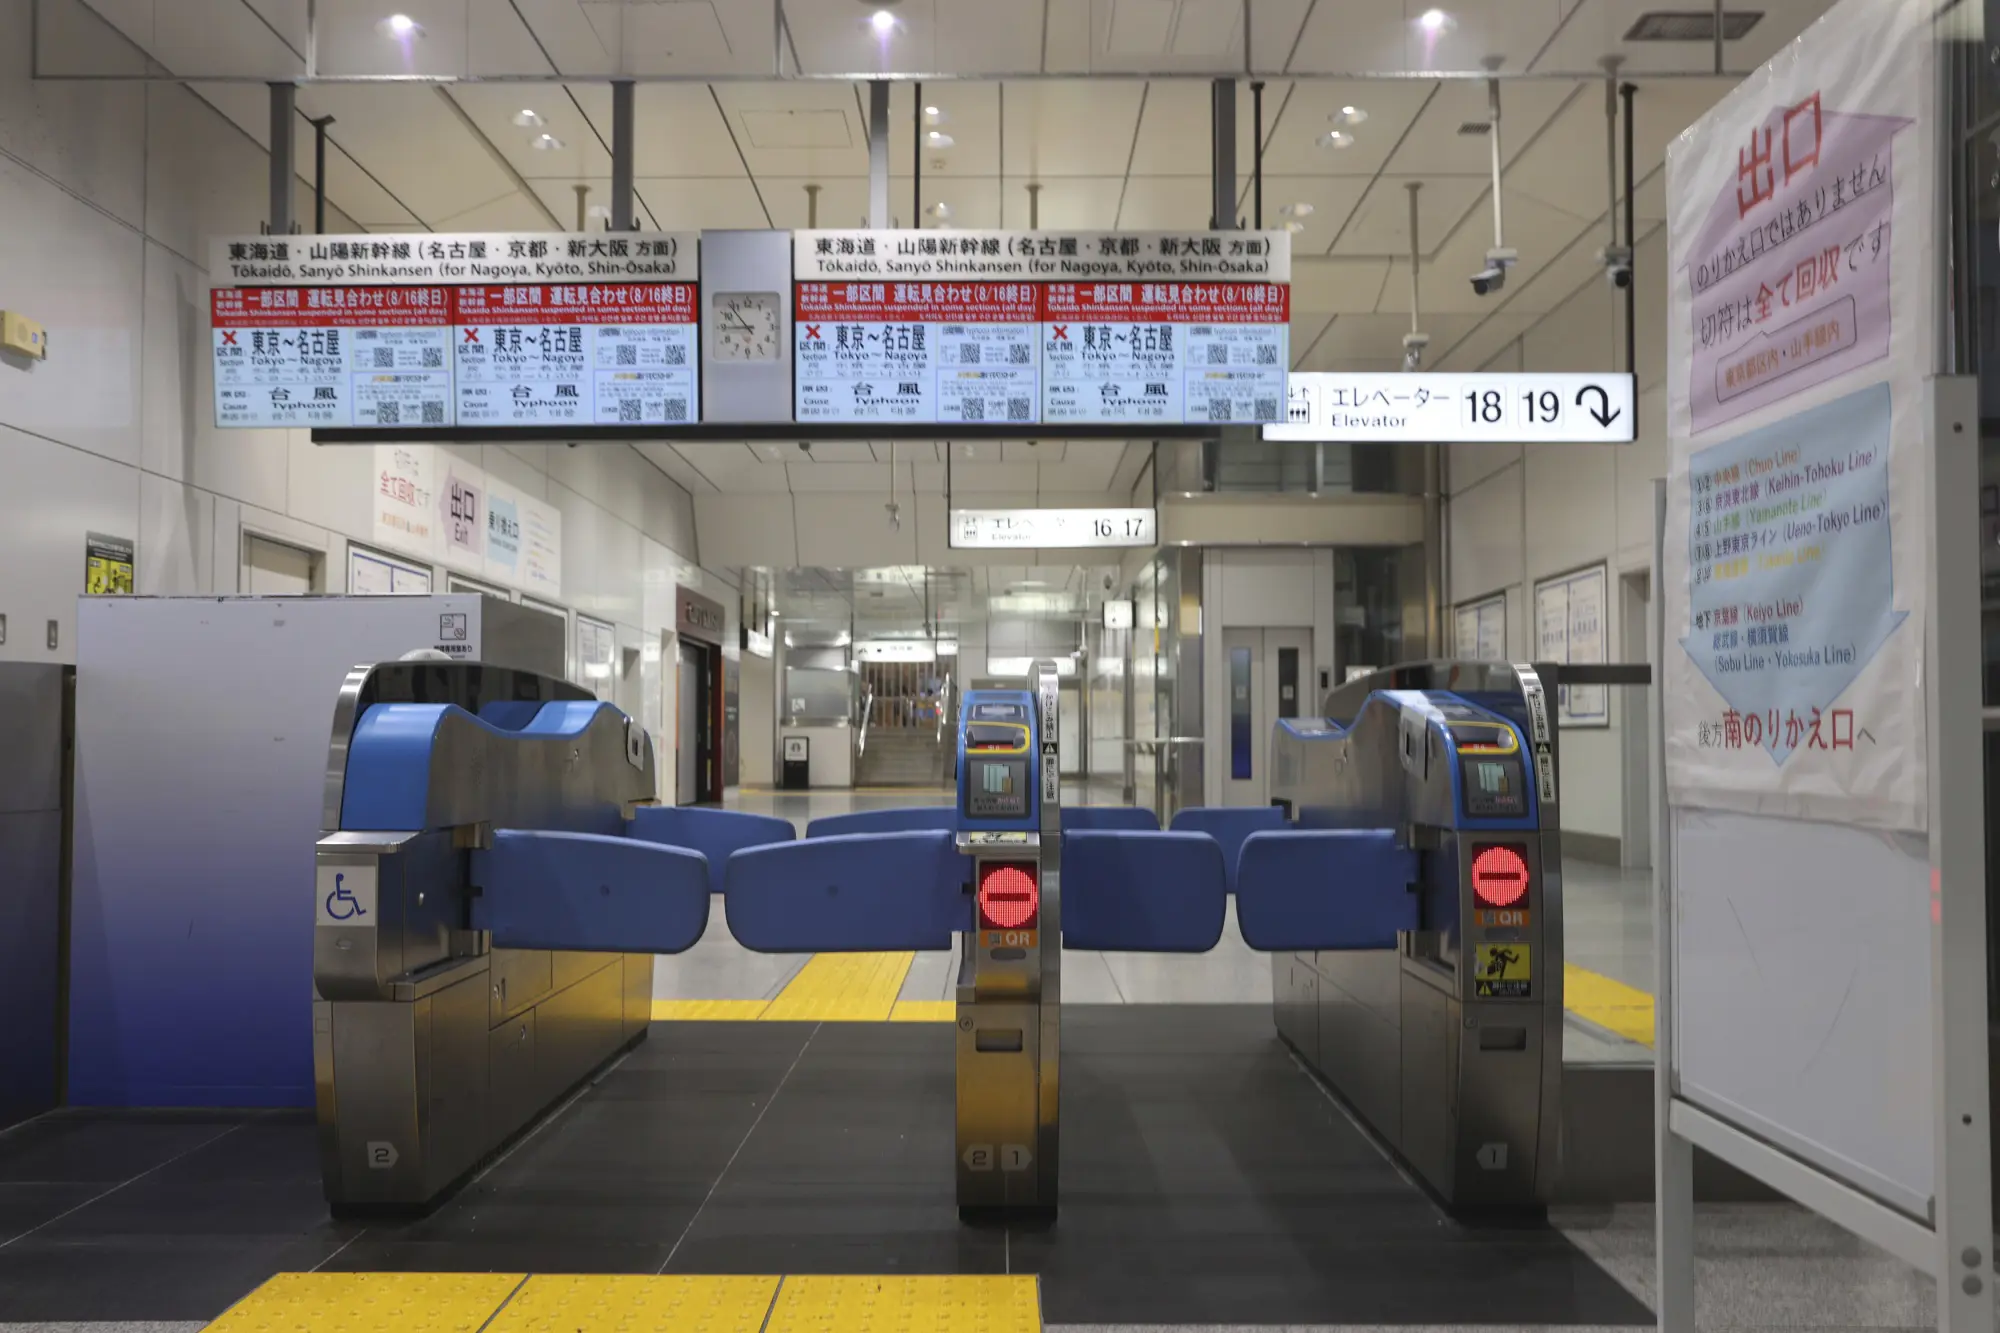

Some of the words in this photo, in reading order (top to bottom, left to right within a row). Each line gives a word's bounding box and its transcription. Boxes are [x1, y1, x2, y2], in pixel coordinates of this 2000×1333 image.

[1736, 89, 1822, 220] 出口
[1697, 154, 1886, 288] のりかえ口ではありません
[348, 262, 433, 278] Shinkansen
[440, 262, 466, 278] (for
[471, 262, 531, 279] Nagoya,
[936, 258, 1022, 273] Shinkansen
[1028, 258, 1056, 273] (for
[1061, 259, 1122, 276] Nagoya,
[1701, 219, 1887, 349] 切符は全て回収です
[300, 356, 342, 366] Nagoya
[542, 353, 584, 363] Nagoya
[884, 351, 927, 361] Nagoya
[1132, 351, 1175, 361] Nagoya
[1332, 387, 1450, 408] エレベーター
[1464, 390, 1502, 423] 18
[1522, 390, 1560, 423] 19
[1332, 414, 1408, 429] Elevator
[450, 482, 475, 524] 出口
[1852, 498, 1886, 524] Line)
[454, 522, 469, 545] Exit
[1094, 519, 1112, 537] 16
[1125, 517, 1143, 537] 17
[1776, 596, 1804, 617] Line)
[1824, 642, 1857, 665] Line)
[1500, 911, 1522, 925] QR
[1005, 930, 1030, 945] QR
[374, 1147, 390, 1163] 2
[972, 1150, 987, 1165] 2
[1012, 1150, 1019, 1165] 1
